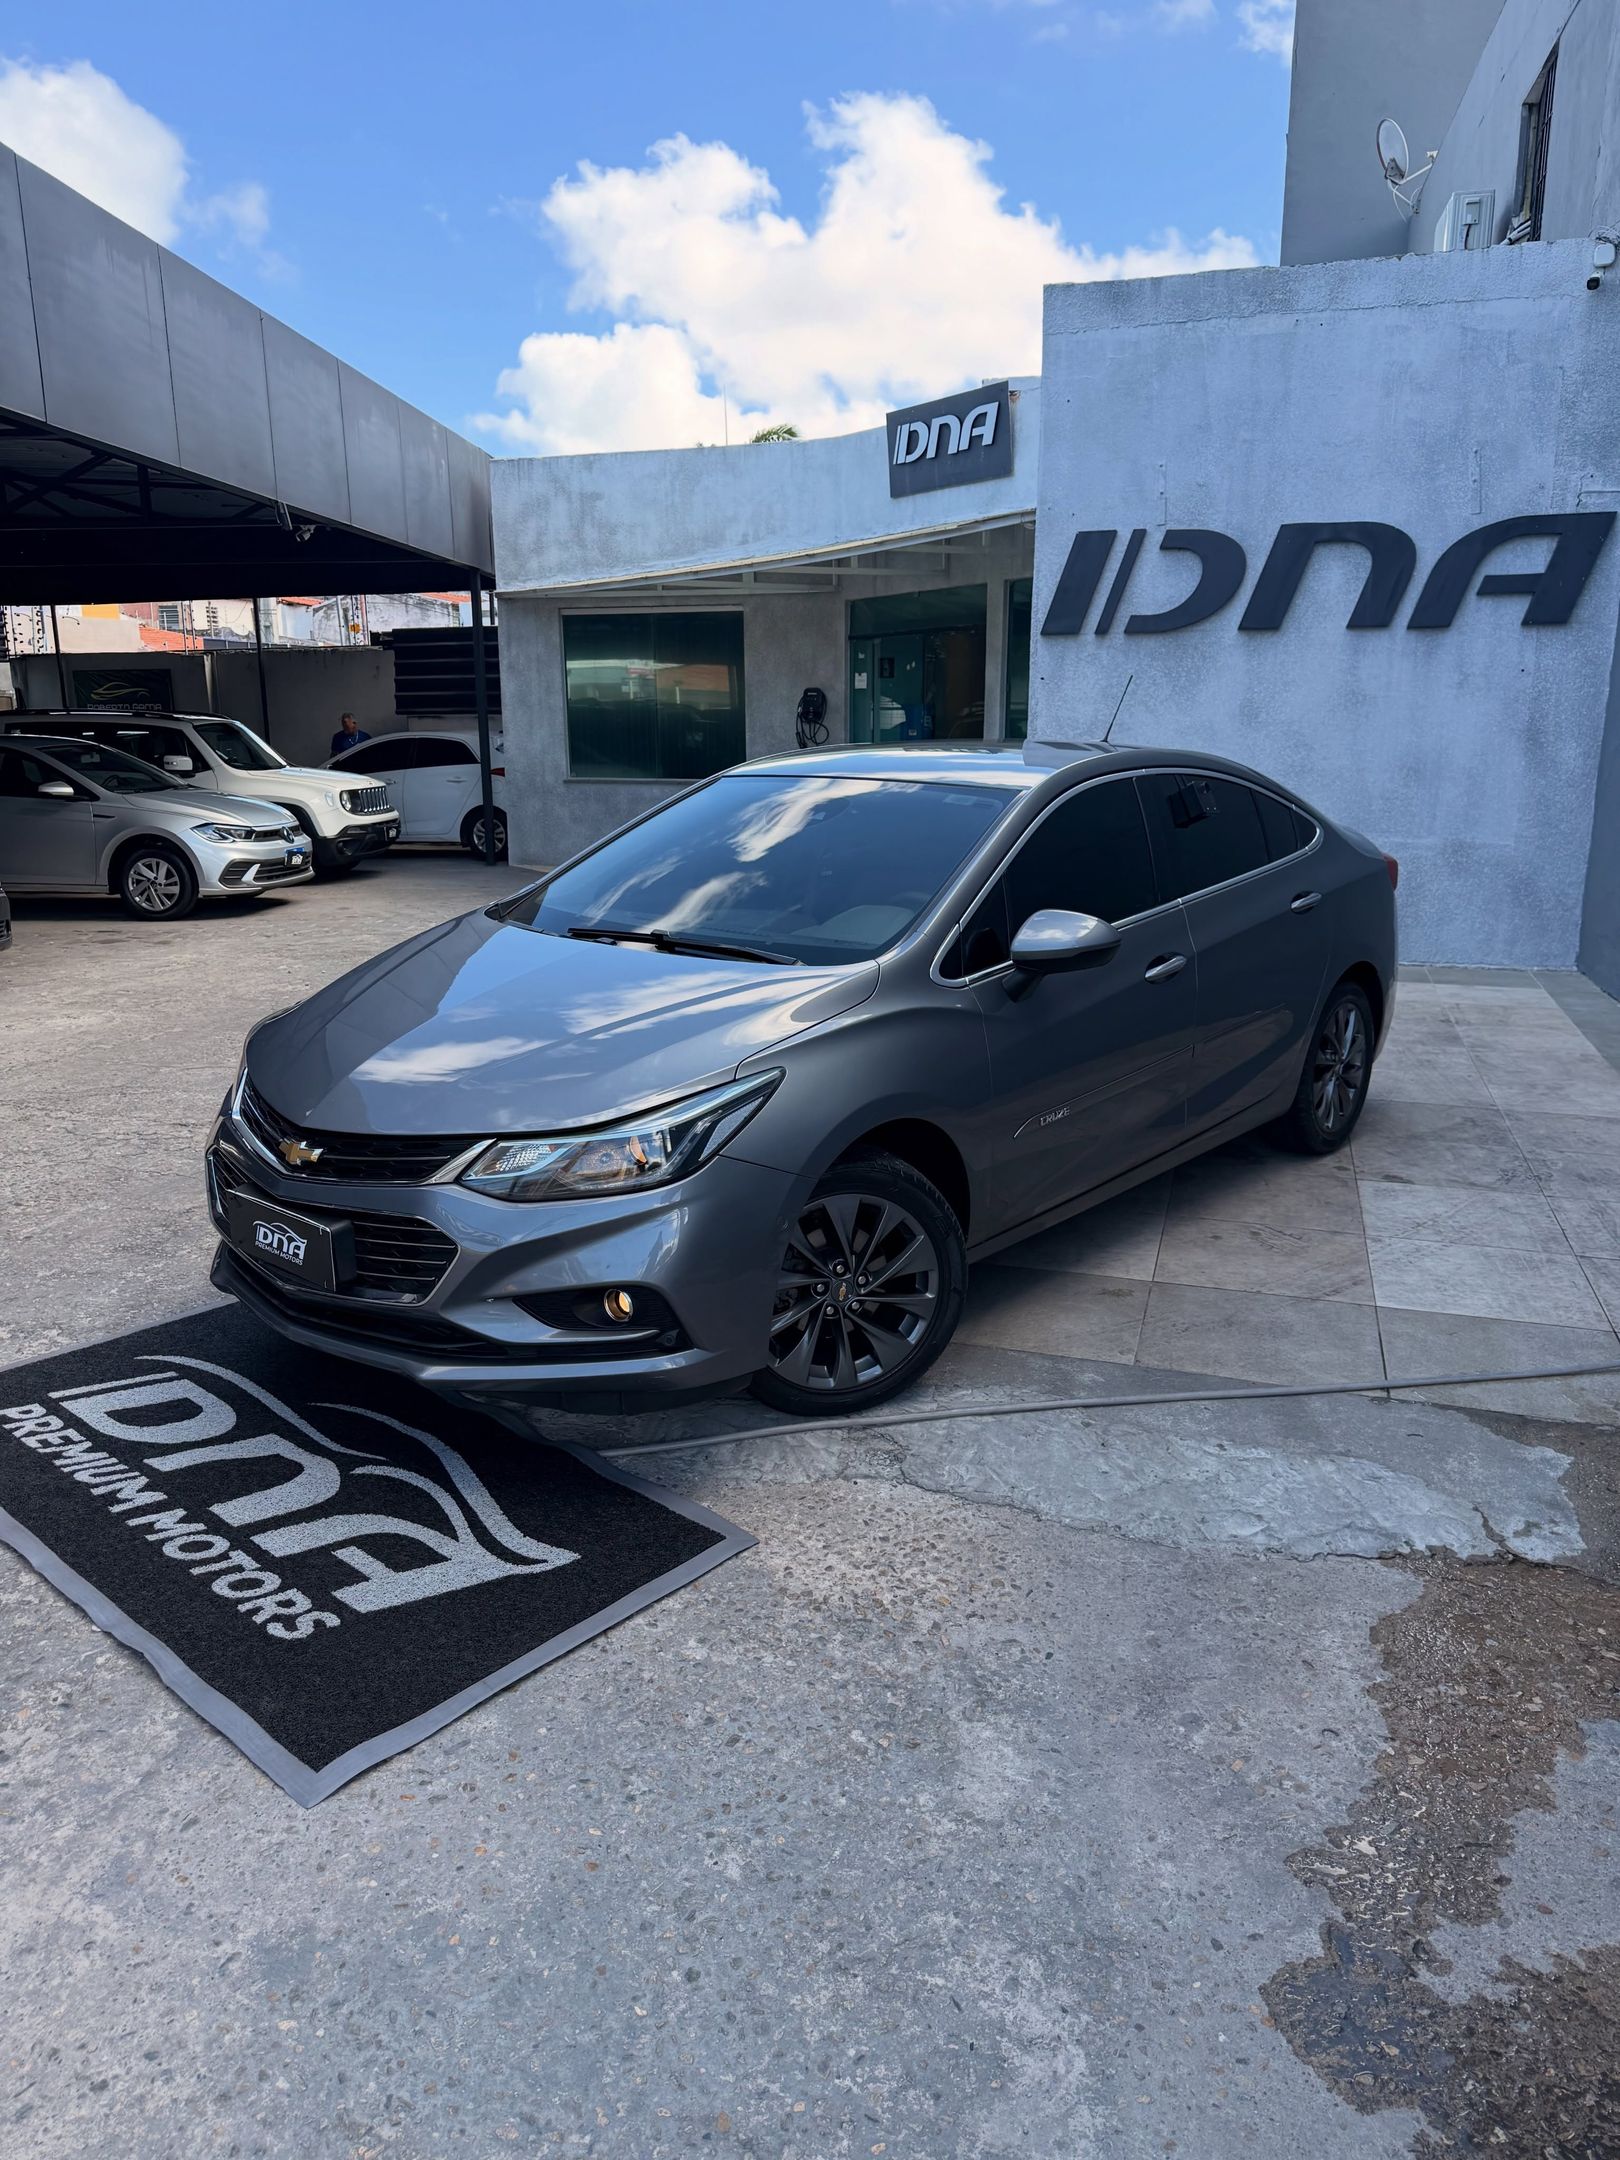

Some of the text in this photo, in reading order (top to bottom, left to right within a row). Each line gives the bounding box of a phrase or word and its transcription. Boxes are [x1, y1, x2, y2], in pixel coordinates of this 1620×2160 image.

[1040, 1107, 1070, 1126] CRUZE
[255, 1241, 303, 1265] PREMIUM MOTORS
[0, 1403, 341, 1640] PREMIUM MOTORS
